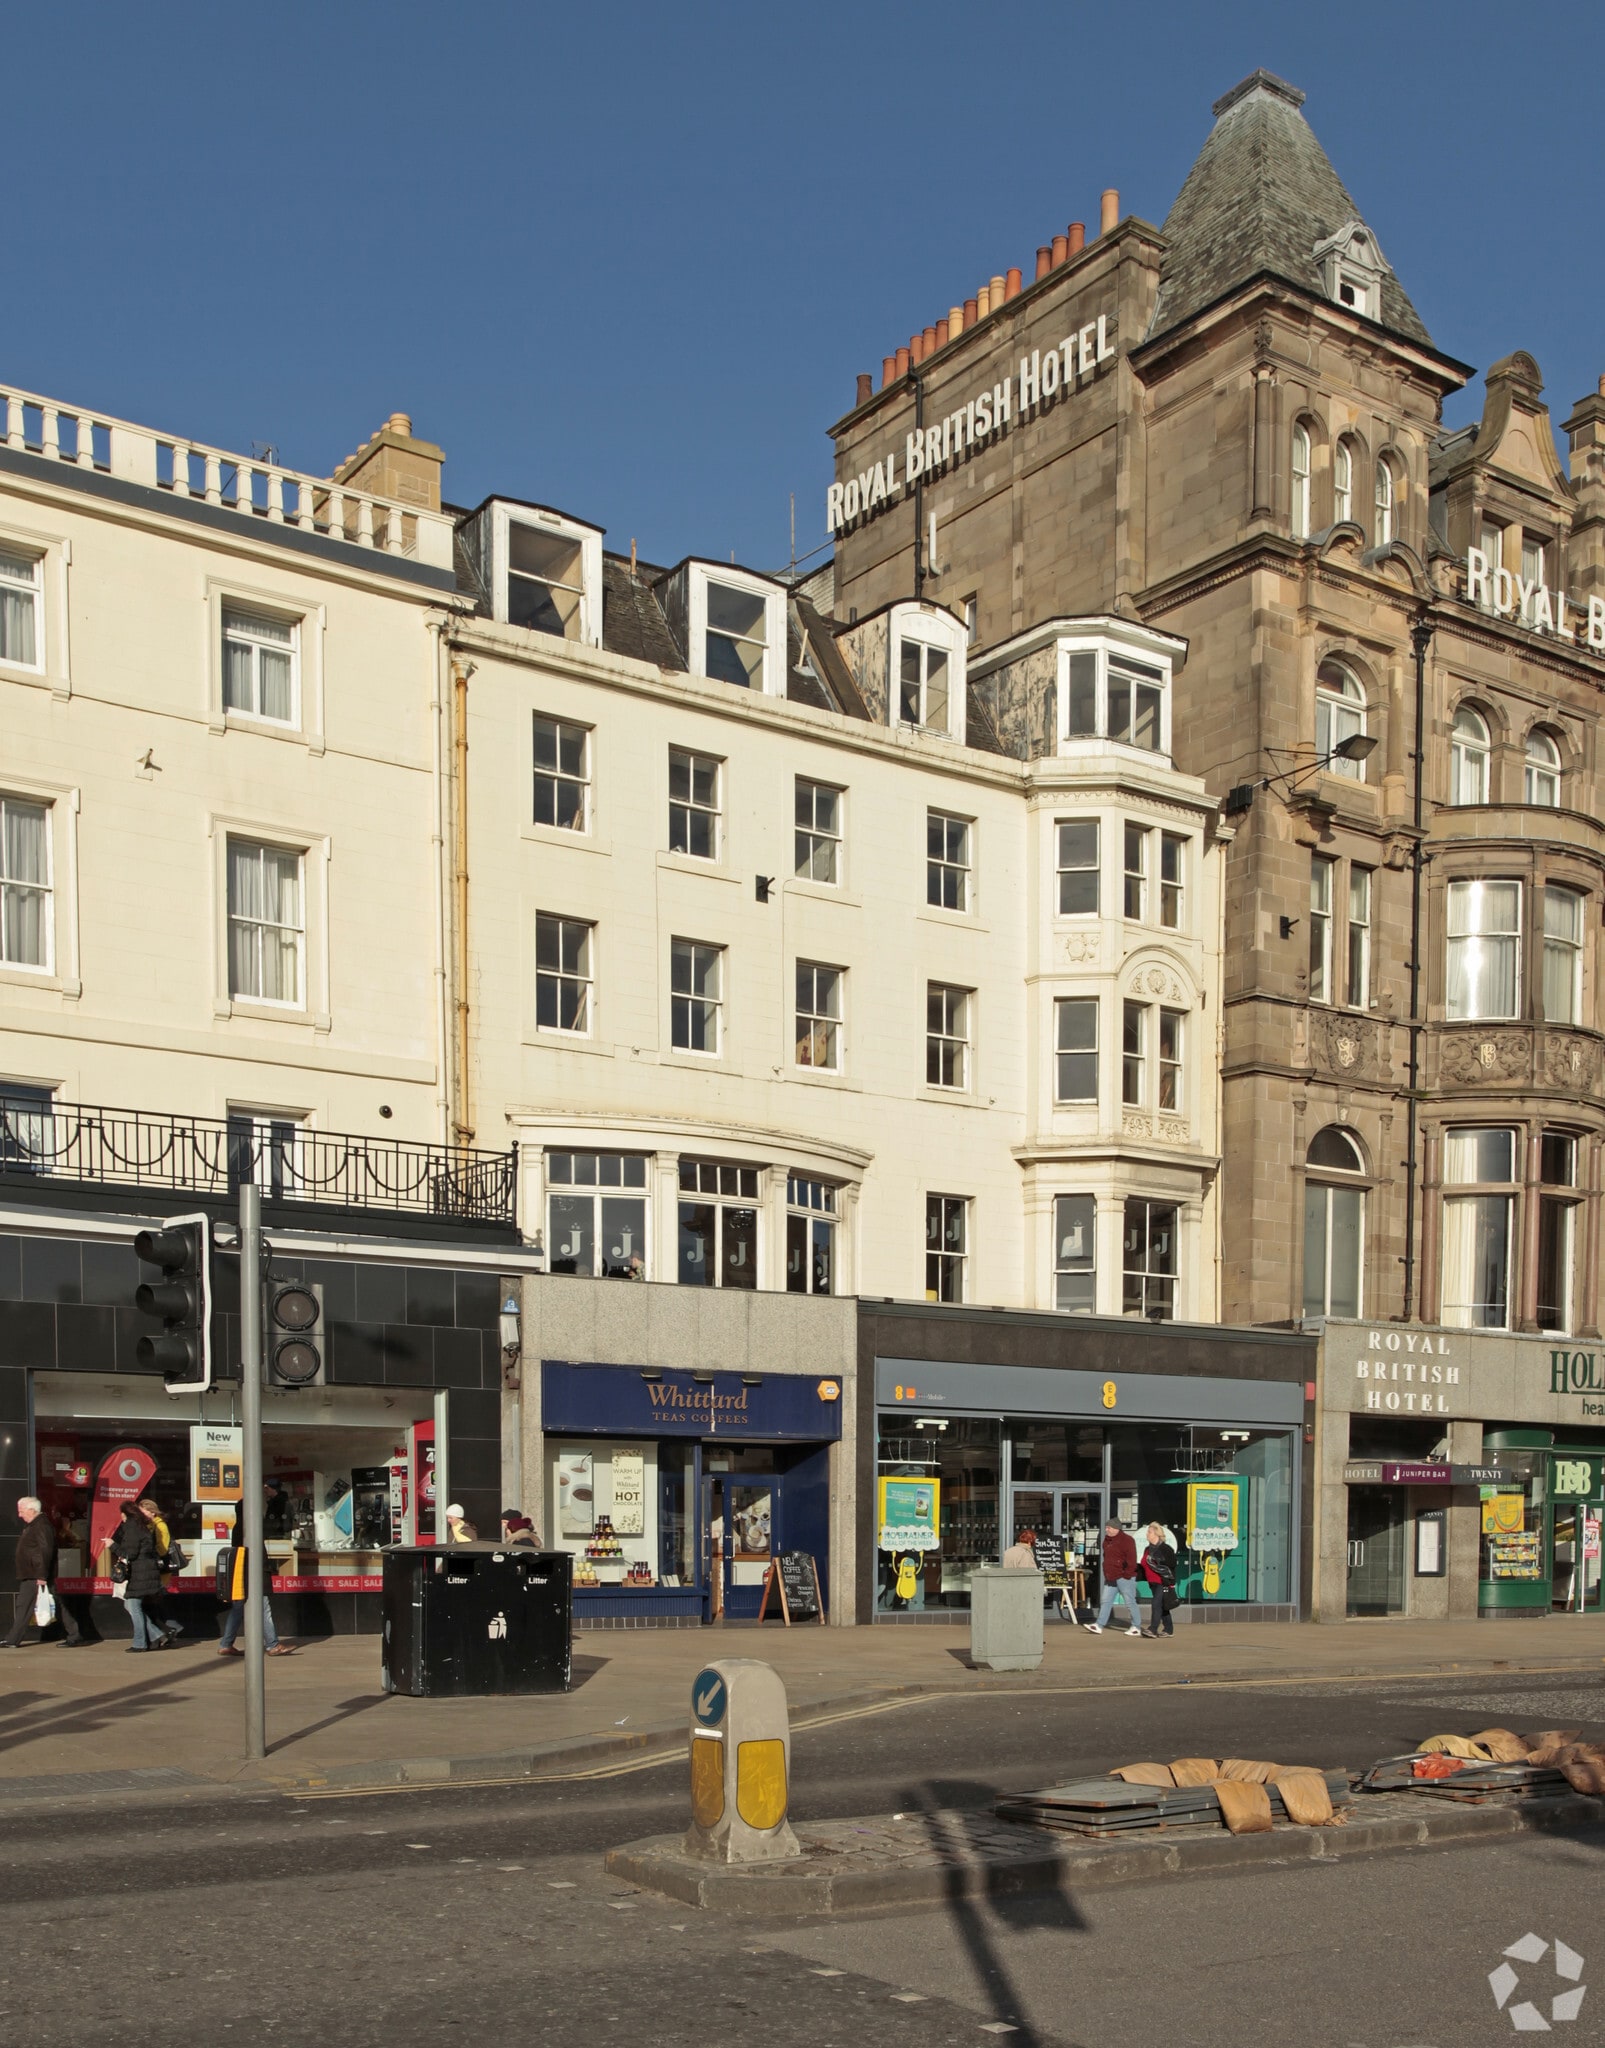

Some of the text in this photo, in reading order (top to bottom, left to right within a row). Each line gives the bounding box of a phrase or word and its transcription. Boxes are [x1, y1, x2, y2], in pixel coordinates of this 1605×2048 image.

[826, 314, 1115, 533] ROYAL BRITISH HOTEL
[1467, 545, 1574, 639] ROYAL
[1368, 1331, 1450, 1355] ROYAL
[1356, 1360, 1459, 1385] BRITISH
[646, 1384, 749, 1410] Whittard
[1367, 1390, 1449, 1413] HOTEL
[652, 1411, 749, 1424] TEAS COFFEES
[206, 1431, 232, 1442] New
[1344, 1468, 1381, 1478] HOTEL
[1401, 1469, 1431, 1478] JUNIPER
[1470, 1469, 1503, 1479] TWENTY
[615, 1491, 640, 1501] HOT
[884, 1531, 934, 1540] NO BRAINER
[783, 1565, 802, 1574] COFFEE
[286, 1580, 308, 1588] SALE
[313, 1580, 334, 1588] SALE
[338, 1580, 359, 1588] SALE
[447, 1576, 468, 1585] Litter
[528, 1576, 548, 1585] Litter
